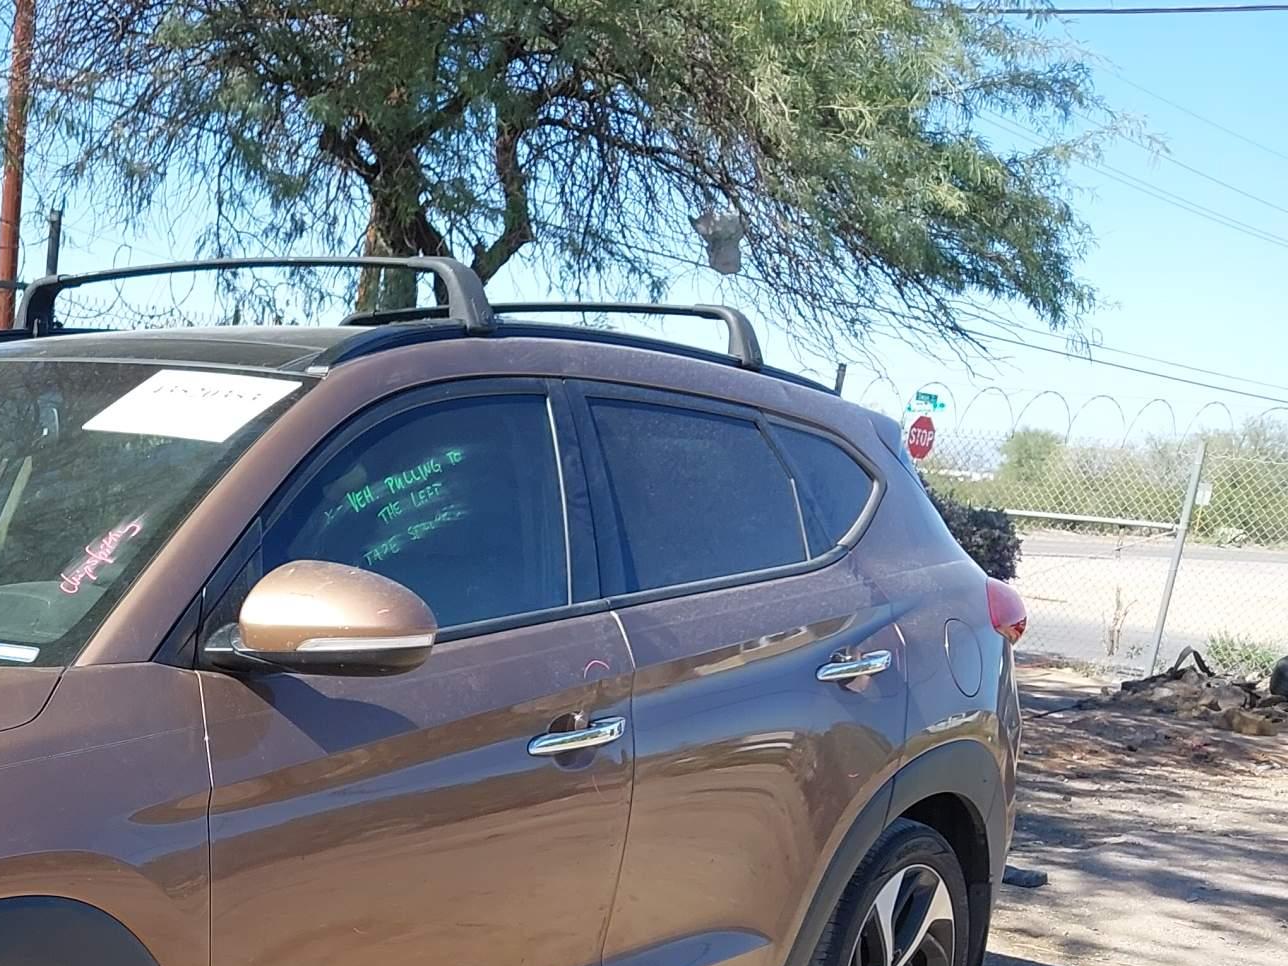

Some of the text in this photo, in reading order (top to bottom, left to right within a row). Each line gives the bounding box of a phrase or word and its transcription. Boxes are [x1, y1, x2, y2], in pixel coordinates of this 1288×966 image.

[909, 427, 934, 447] STOP
[384, 458, 442, 494] PULLING
[446, 450, 463, 466] TO
[378, 483, 442, 524] THE LEFT
